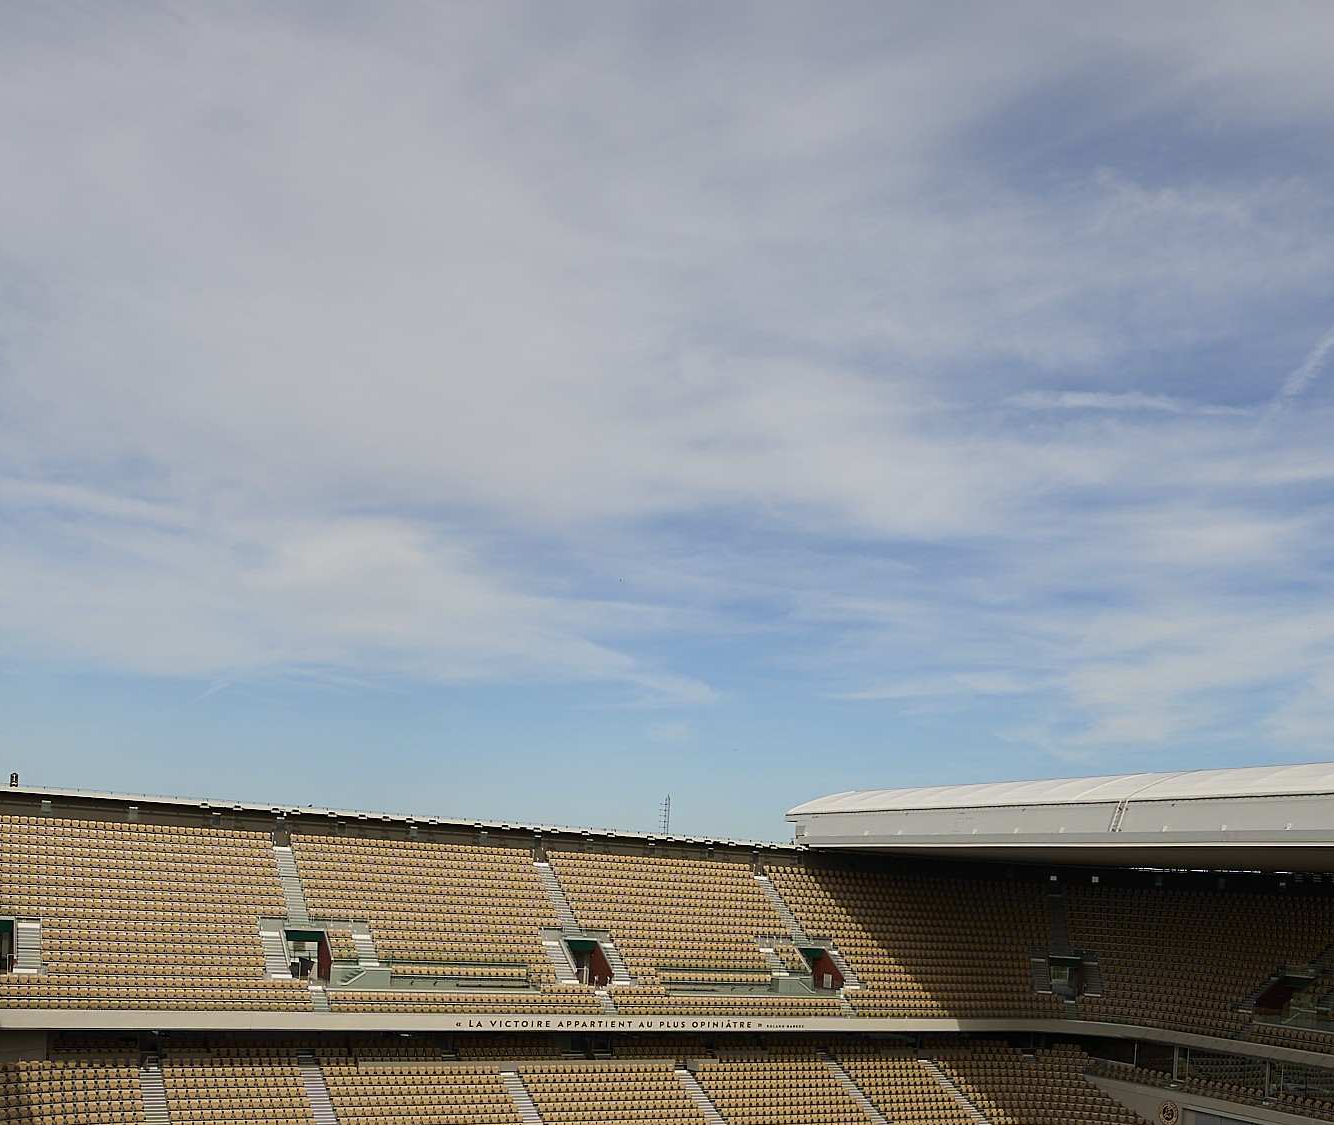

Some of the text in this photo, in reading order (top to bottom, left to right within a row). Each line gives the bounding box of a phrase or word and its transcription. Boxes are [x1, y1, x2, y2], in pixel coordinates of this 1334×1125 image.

[468, 1019, 483, 1028] LA
[490, 1020, 551, 1028] VICTOIRE
[558, 1020, 633, 1028] APPARTIENT
[691, 1019, 752, 1029] OPINIÂTRE
